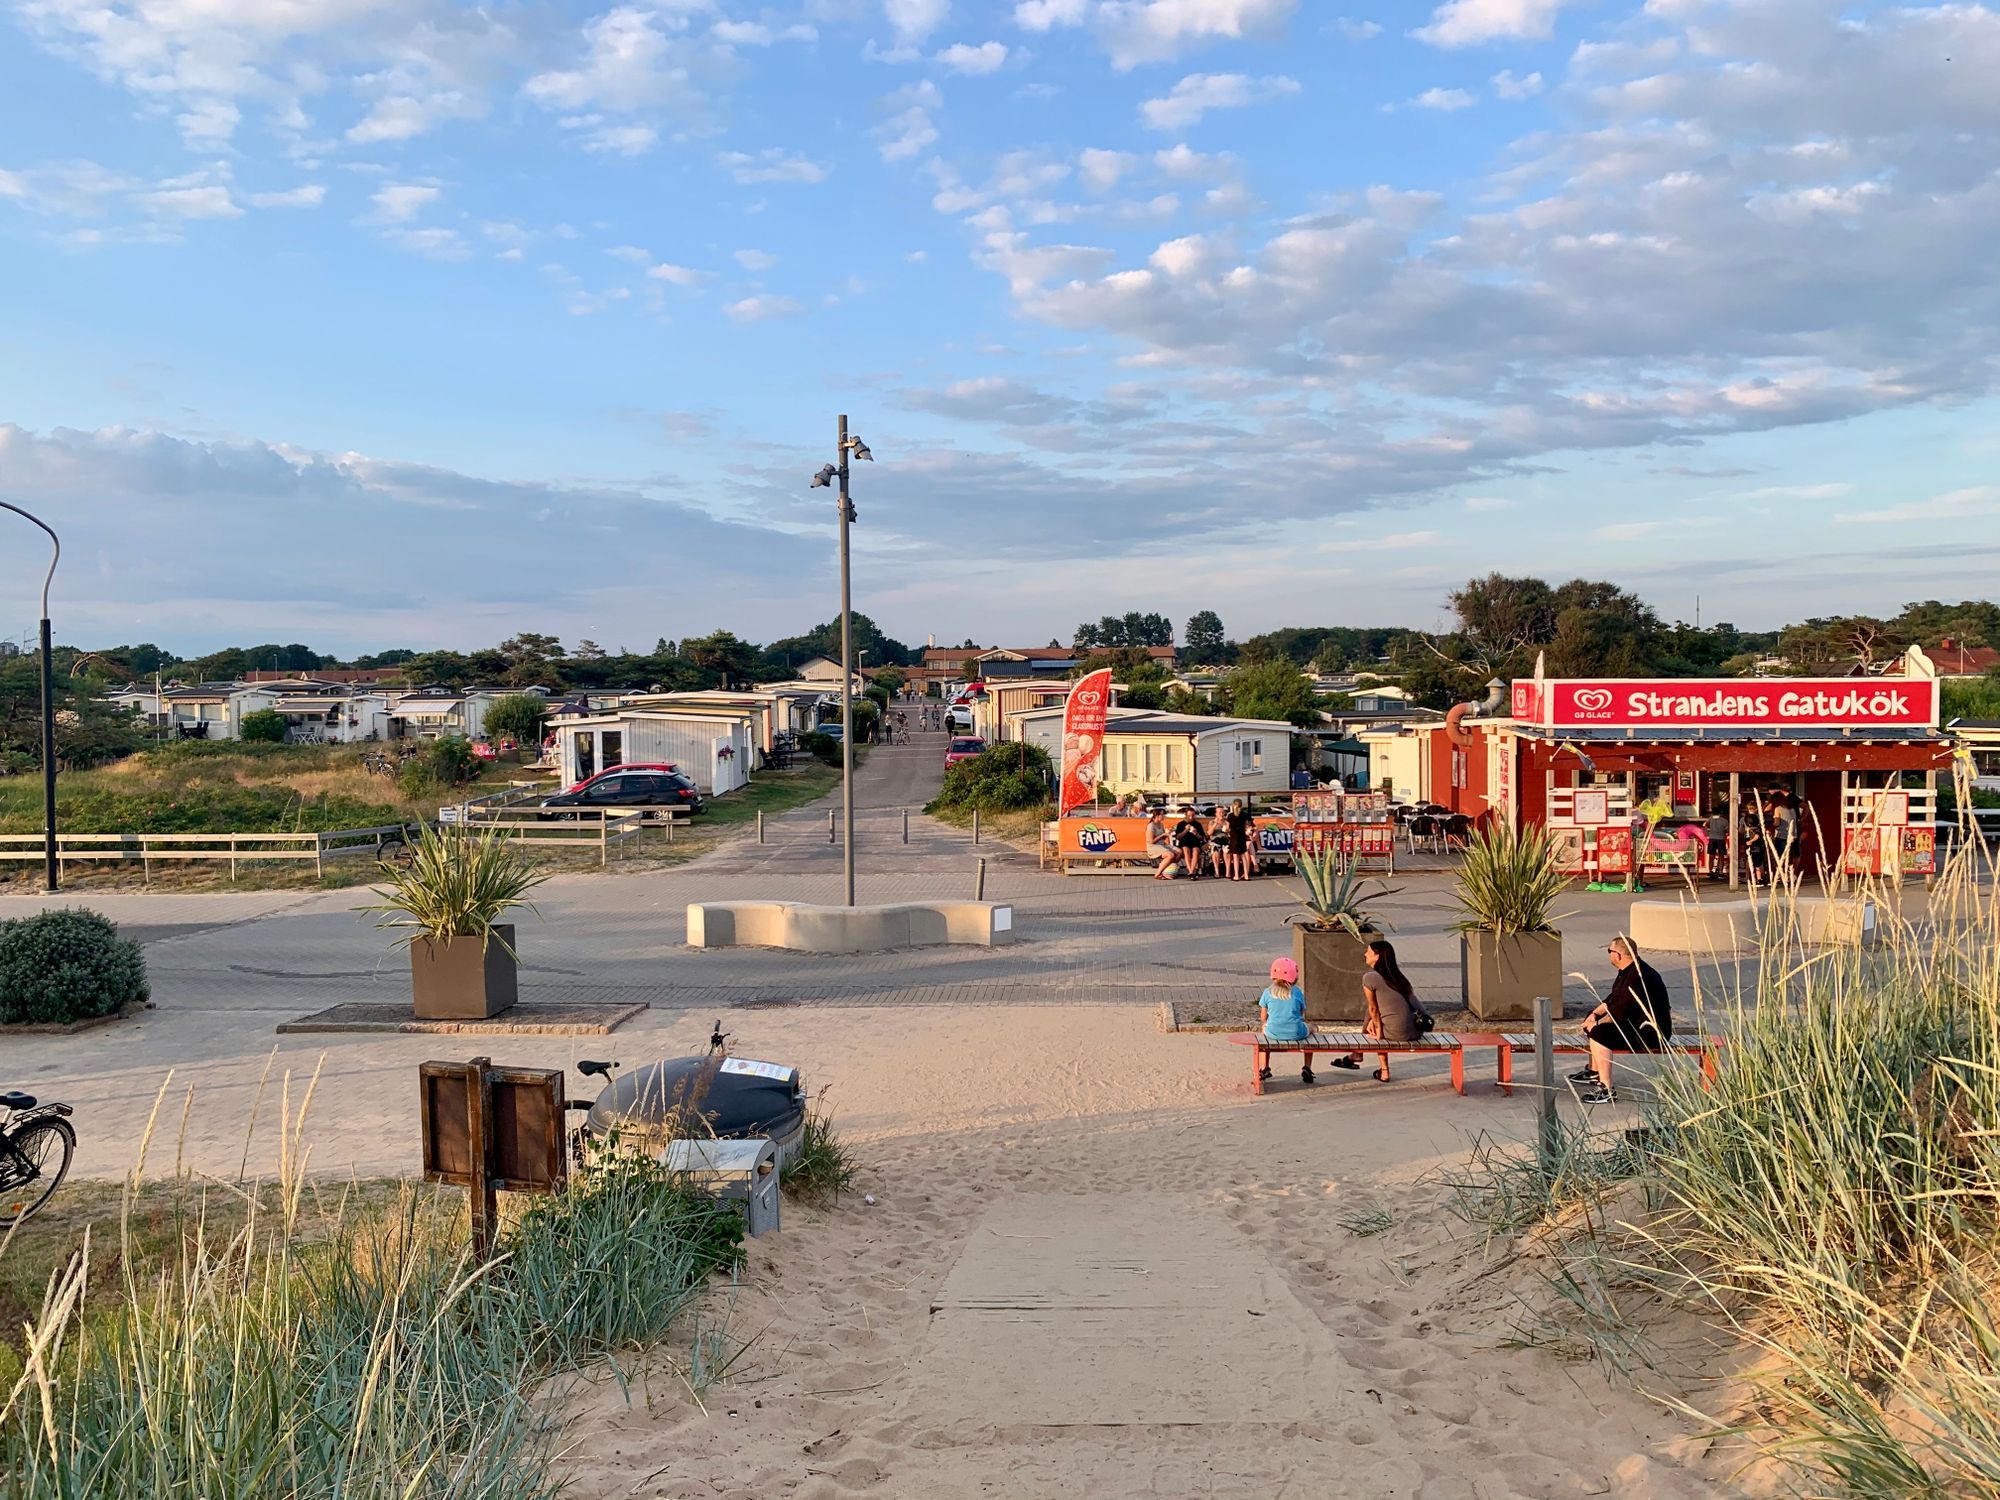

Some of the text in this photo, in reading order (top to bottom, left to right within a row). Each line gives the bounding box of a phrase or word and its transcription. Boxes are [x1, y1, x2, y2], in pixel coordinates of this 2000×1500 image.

[1627, 690, 1911, 717] Strandens Gatukök
[1574, 711, 1585, 719] GB
[1077, 829, 1117, 846] FANTA
[1259, 830, 1294, 846] FANT
